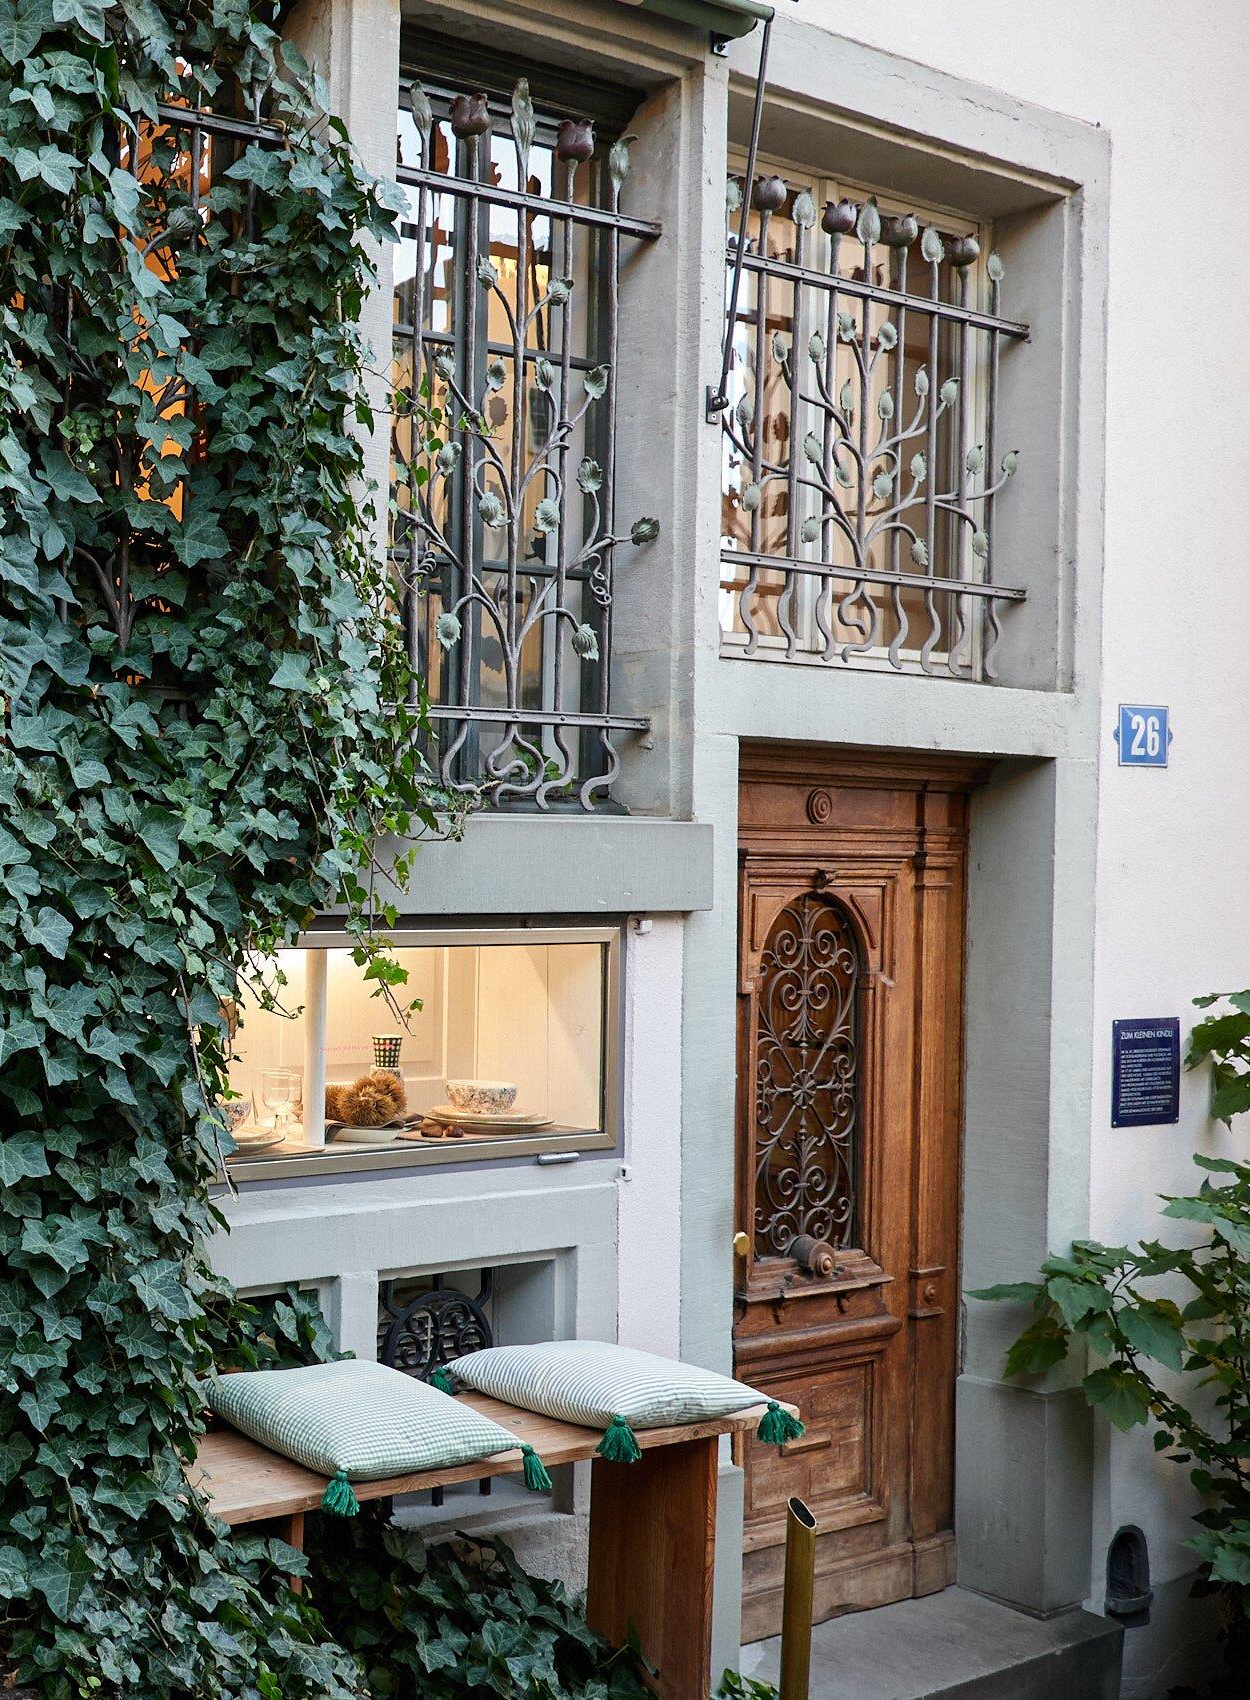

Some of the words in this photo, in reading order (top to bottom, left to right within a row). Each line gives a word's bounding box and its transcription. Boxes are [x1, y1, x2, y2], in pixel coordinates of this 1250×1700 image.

[1131, 714, 1160, 757] 26
[1120, 1031, 1133, 1040] ZUM
[1134, 1030, 1156, 1039] KLEINEN
